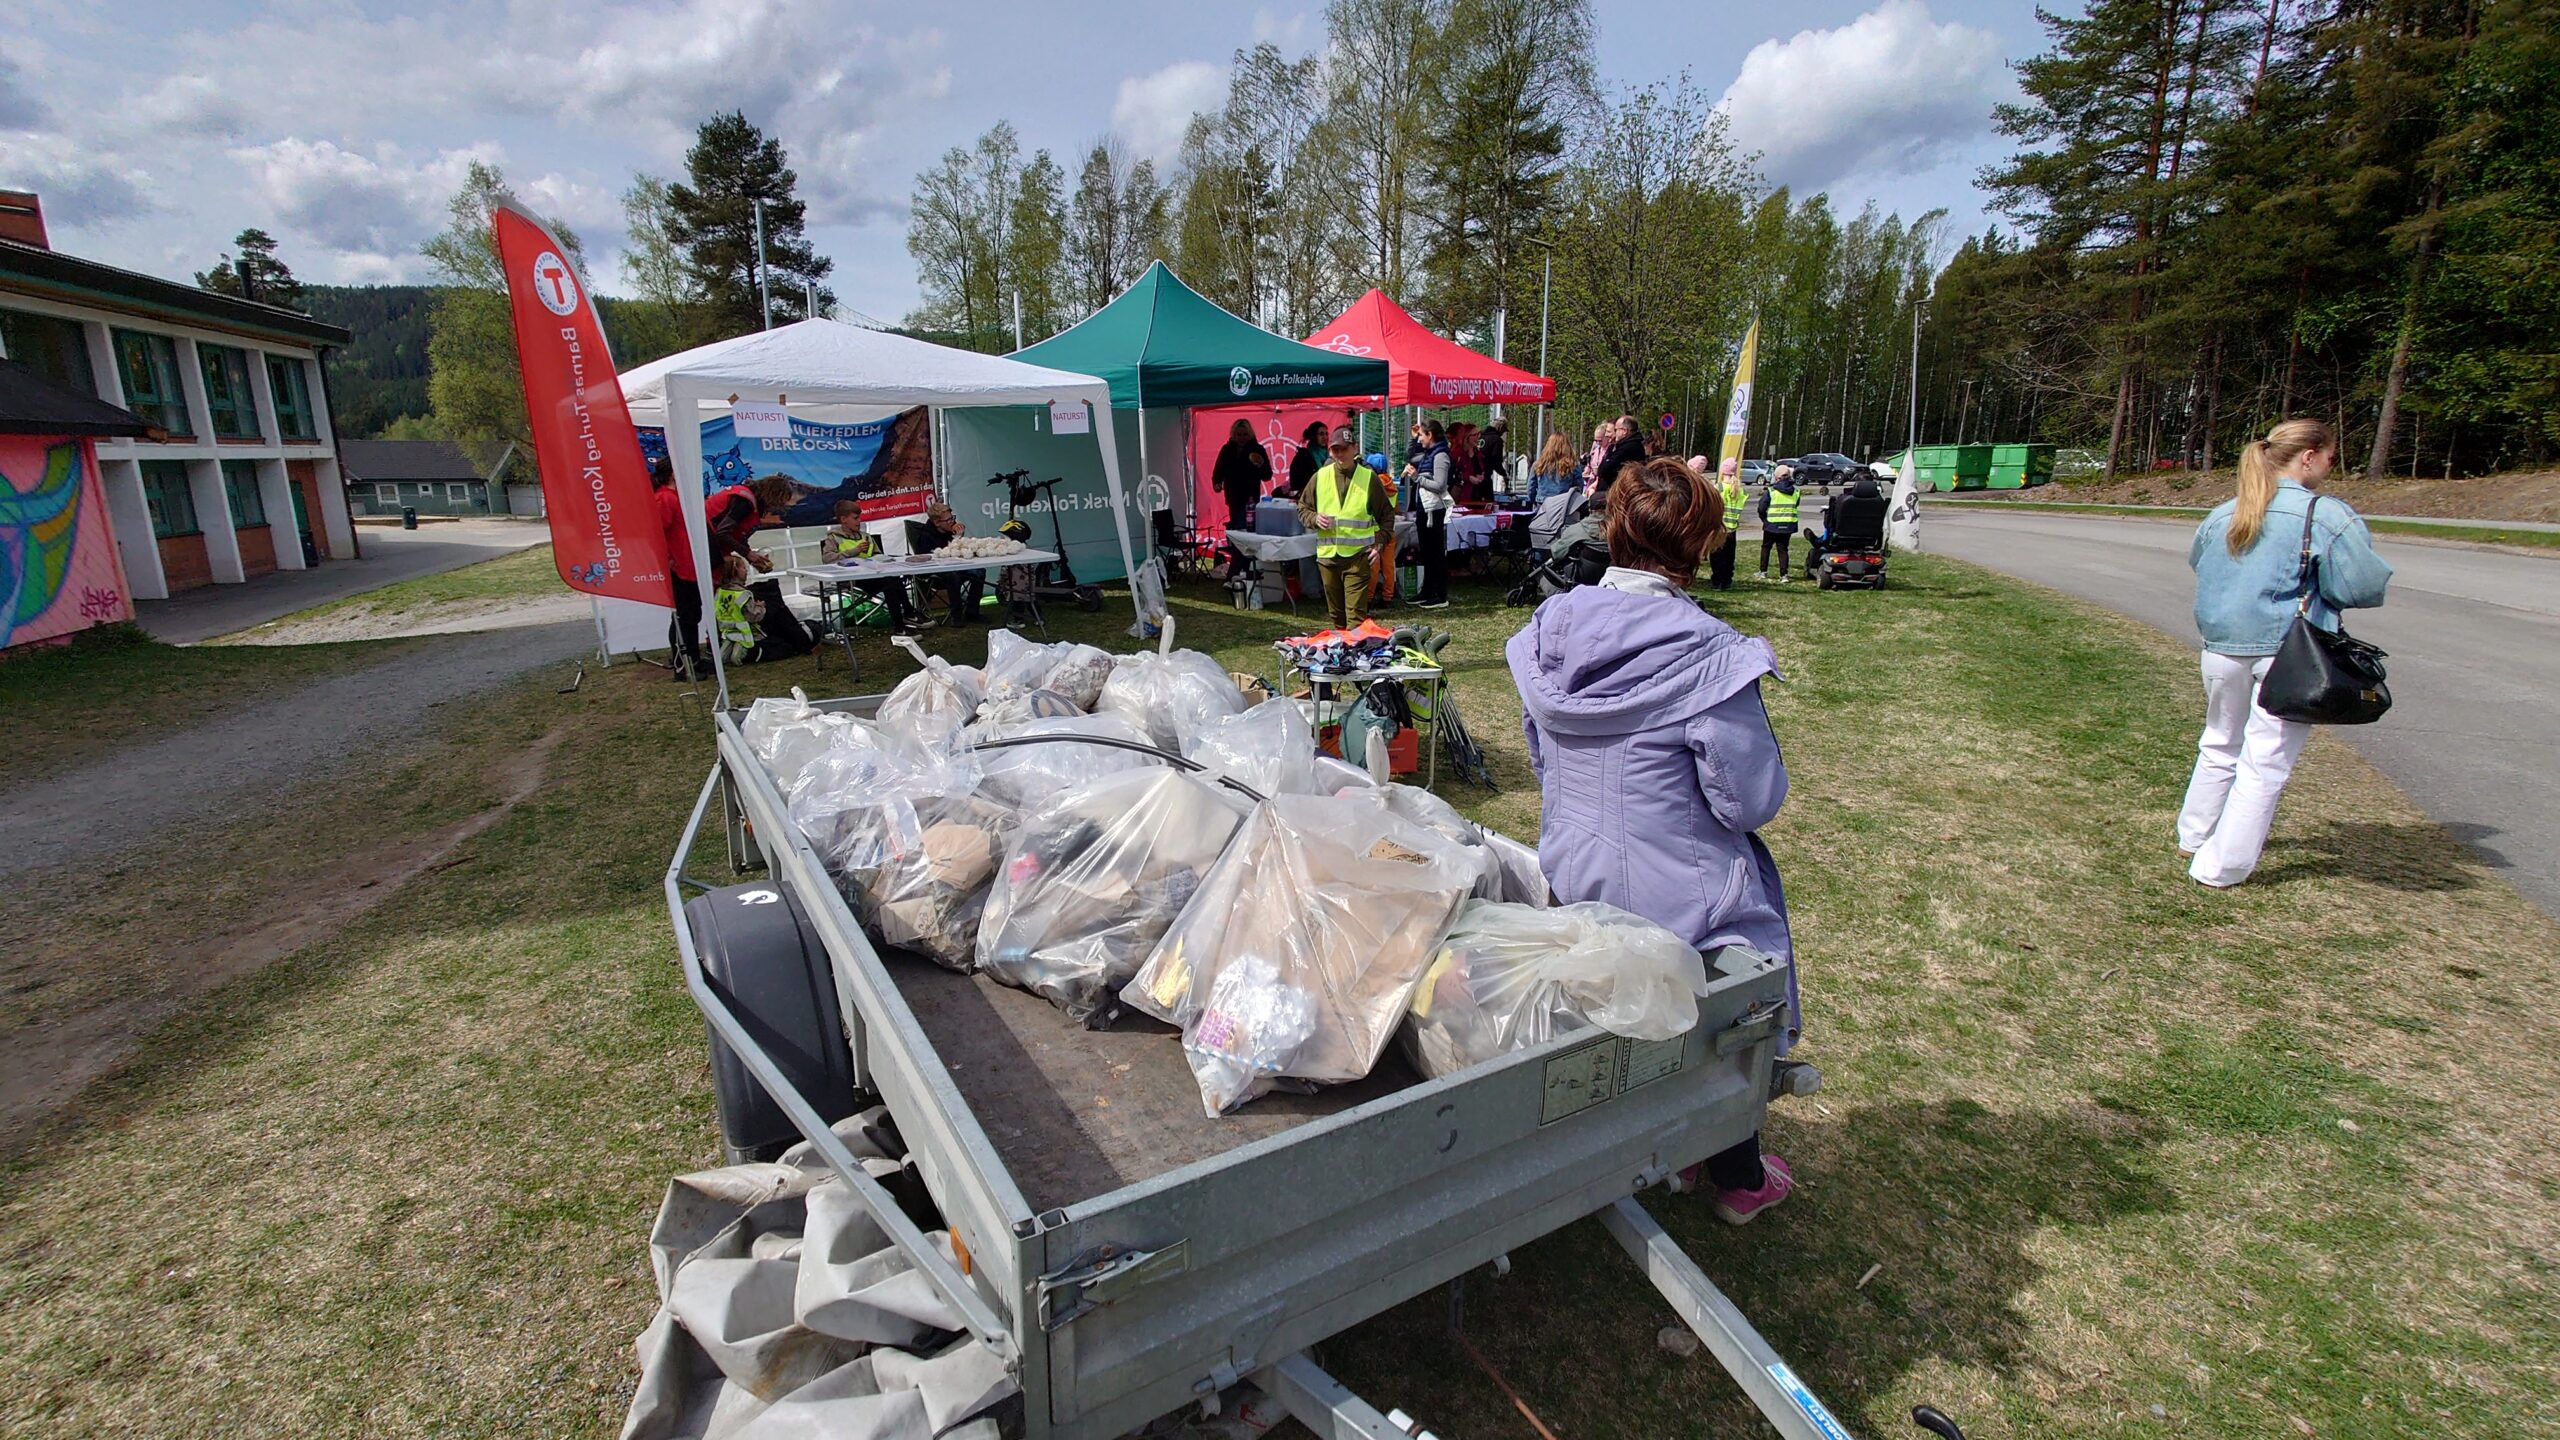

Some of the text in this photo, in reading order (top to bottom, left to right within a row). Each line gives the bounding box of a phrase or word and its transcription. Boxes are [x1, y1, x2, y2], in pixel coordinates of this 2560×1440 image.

[1255, 373, 1325, 386] Norsk Folkehjelp
[1430, 375, 1481, 399] Kongsvinger
[1484, 380, 1493, 399] og
[736, 411, 785, 422] NATURSTI
[1053, 412, 1087, 422] NATURSTI
[792, 424, 881, 437] ILIEMEDLEM
[761, 438, 800, 451] DERE
[857, 490, 875, 501] Gjør
[896, 486, 920, 495] dnt.no
